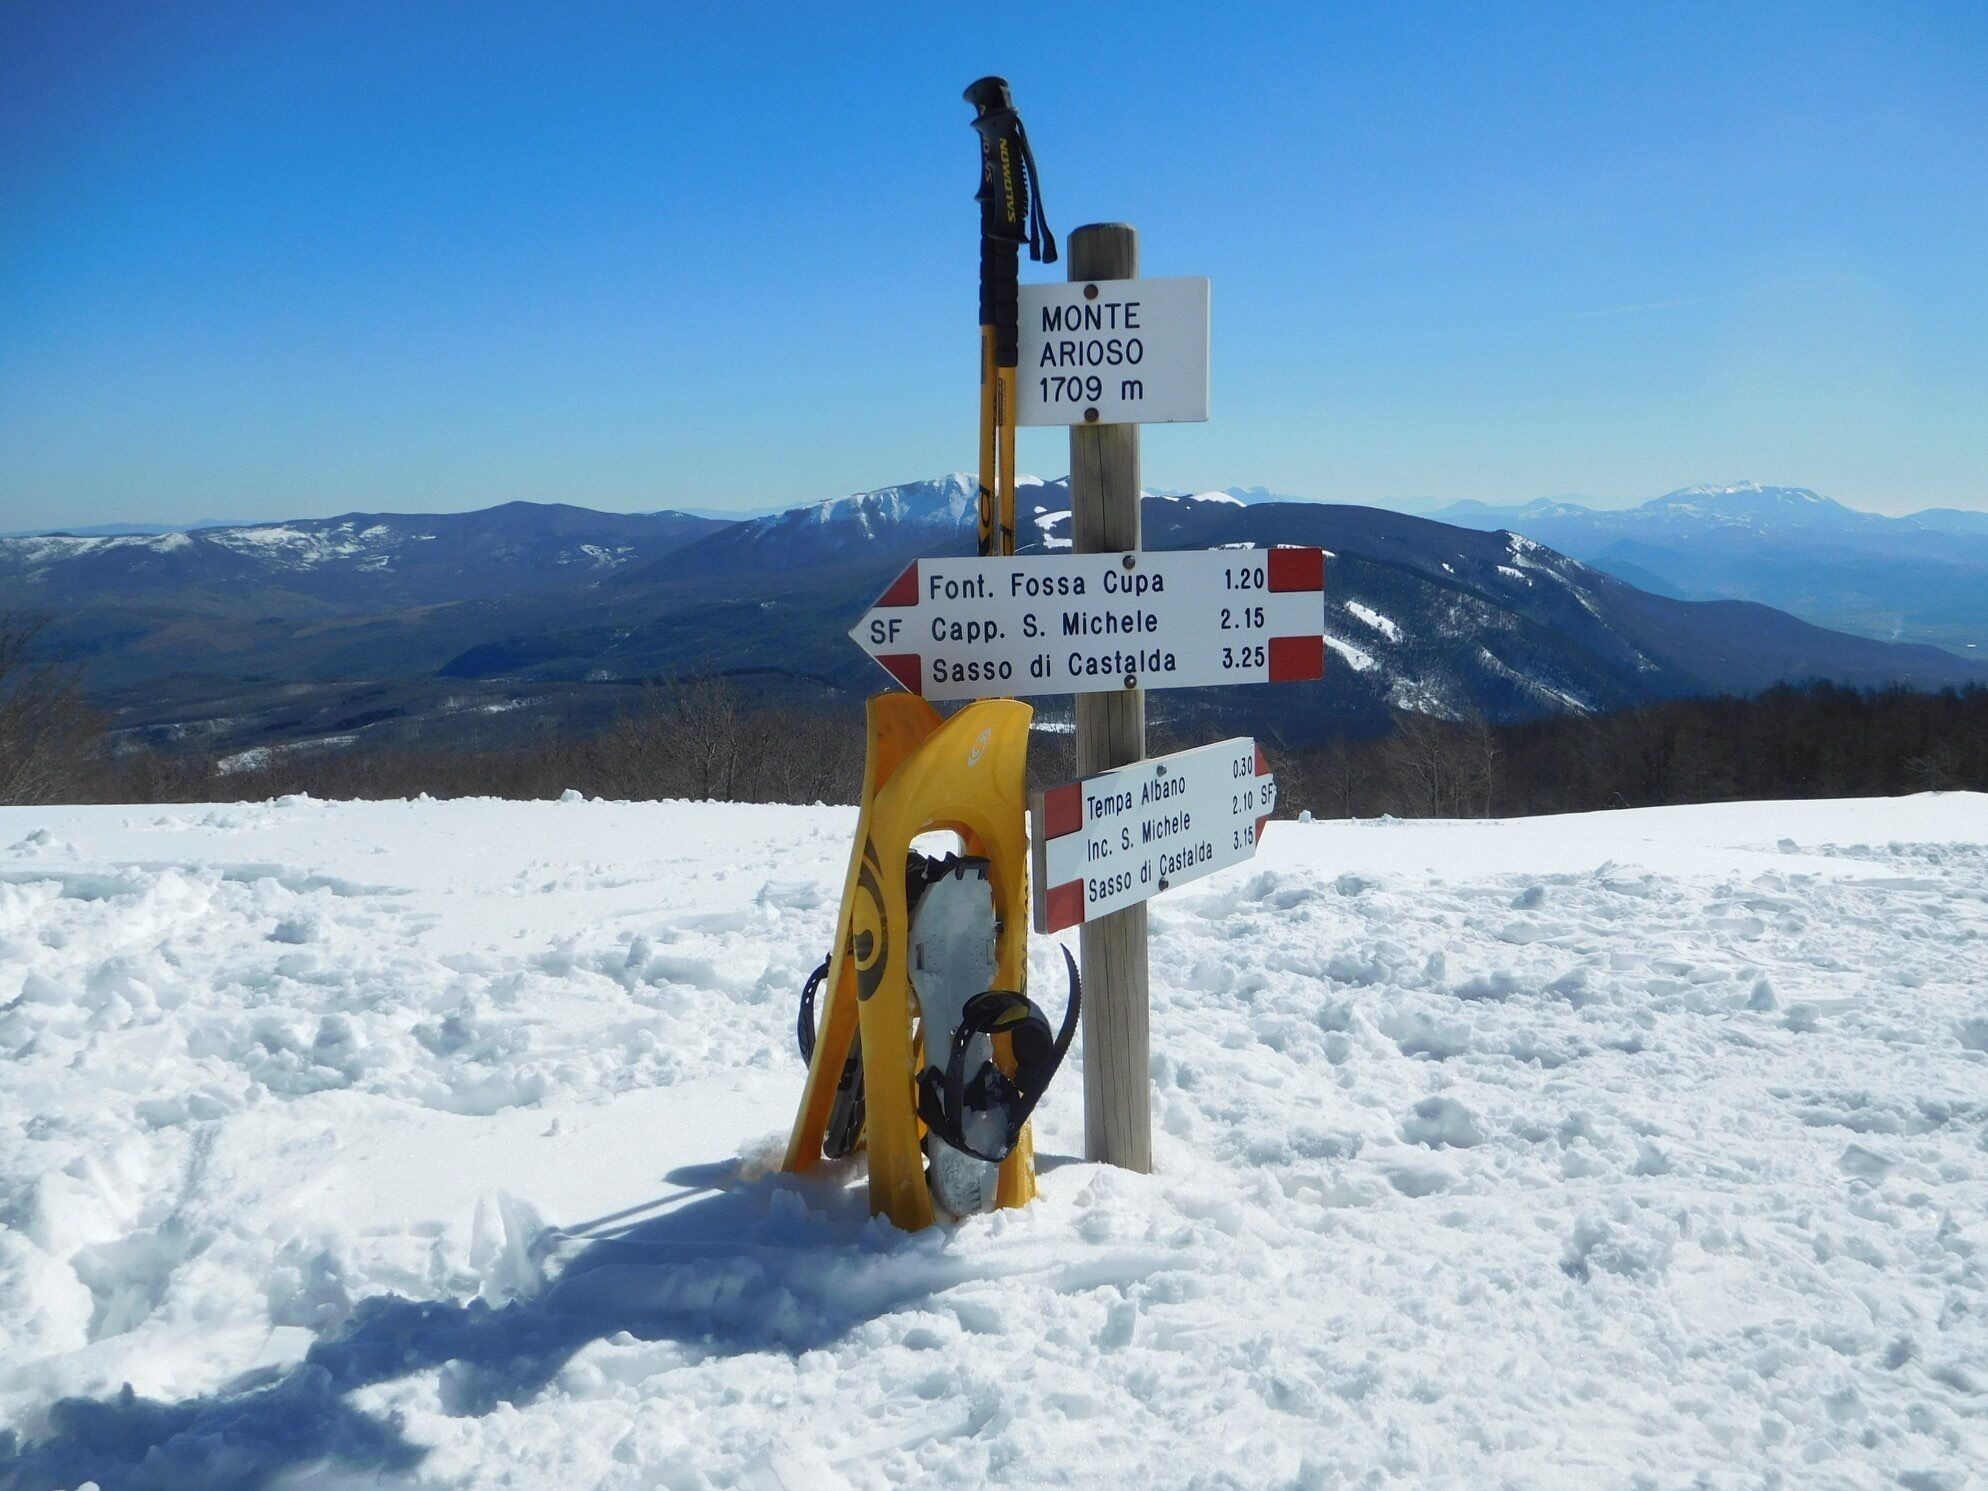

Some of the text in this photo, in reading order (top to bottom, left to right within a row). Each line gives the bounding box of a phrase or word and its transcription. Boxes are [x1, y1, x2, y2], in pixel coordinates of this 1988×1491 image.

[999, 137, 1016, 223] SALOMON
[1043, 302, 1140, 332] MONTE
[1040, 338, 1143, 367] ARIOSO
[1040, 376, 1143, 402] 1709 m
[930, 568, 1264, 599] Font. Fossa Cupa 1.20
[871, 619, 902, 644] SF
[932, 607, 1264, 644] Capp. S. Michele 2.15
[933, 646, 1264, 683] Sasso di Castalda 3.25
[1087, 756, 1252, 820] Tempa Albano 0.30
[1261, 783, 1273, 805] SF
[1088, 791, 1252, 862] Inc. S. Michele 2.10
[1089, 826, 1253, 902] Sasso di Castalda 3.15
